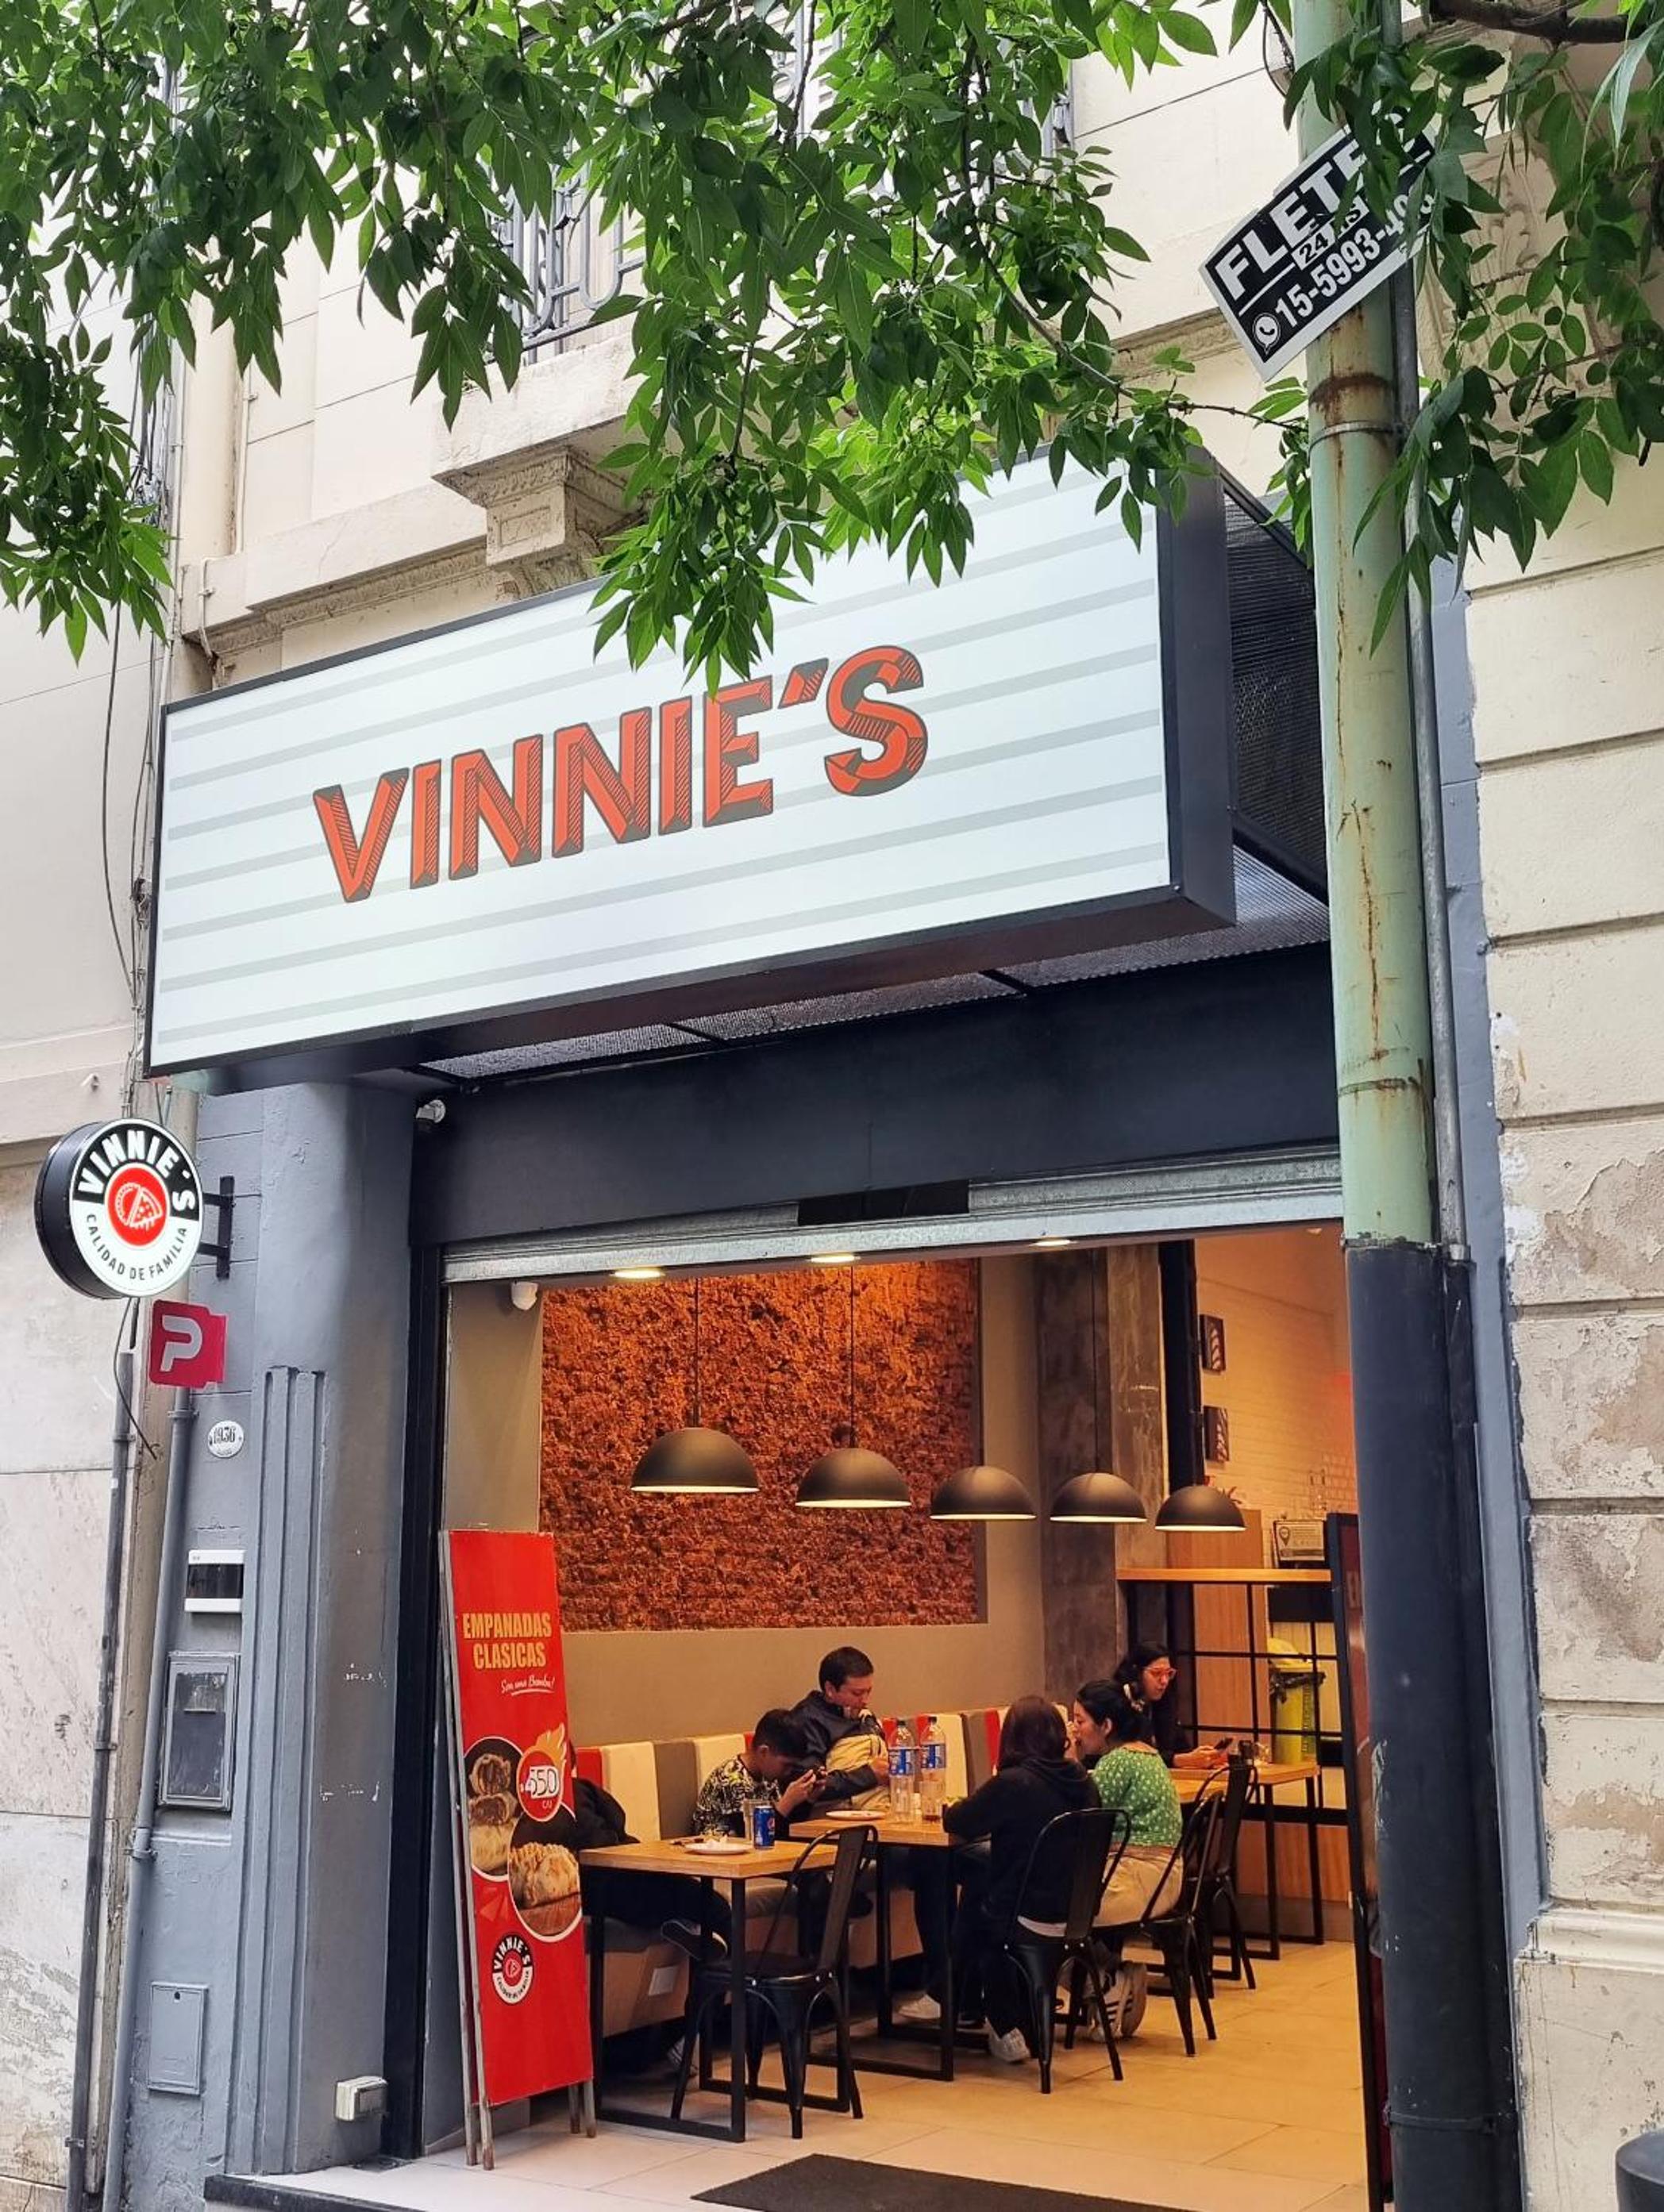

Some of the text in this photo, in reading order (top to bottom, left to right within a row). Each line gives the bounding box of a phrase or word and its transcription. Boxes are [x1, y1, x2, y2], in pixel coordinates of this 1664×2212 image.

[1214, 119, 1410, 301] FLETE
[1300, 233, 1328, 264] 24
[312, 644, 929, 903] VINNIE'S
[78, 1129, 195, 1212] VINNIE'S
[85, 1214, 188, 1281] CALIDAD DE FAMILIA
[462, 1612, 552, 1639] EMPANADAS
[473, 1641, 547, 1670] CLASICAS
[493, 1936, 531, 1970] VINNIE'S
